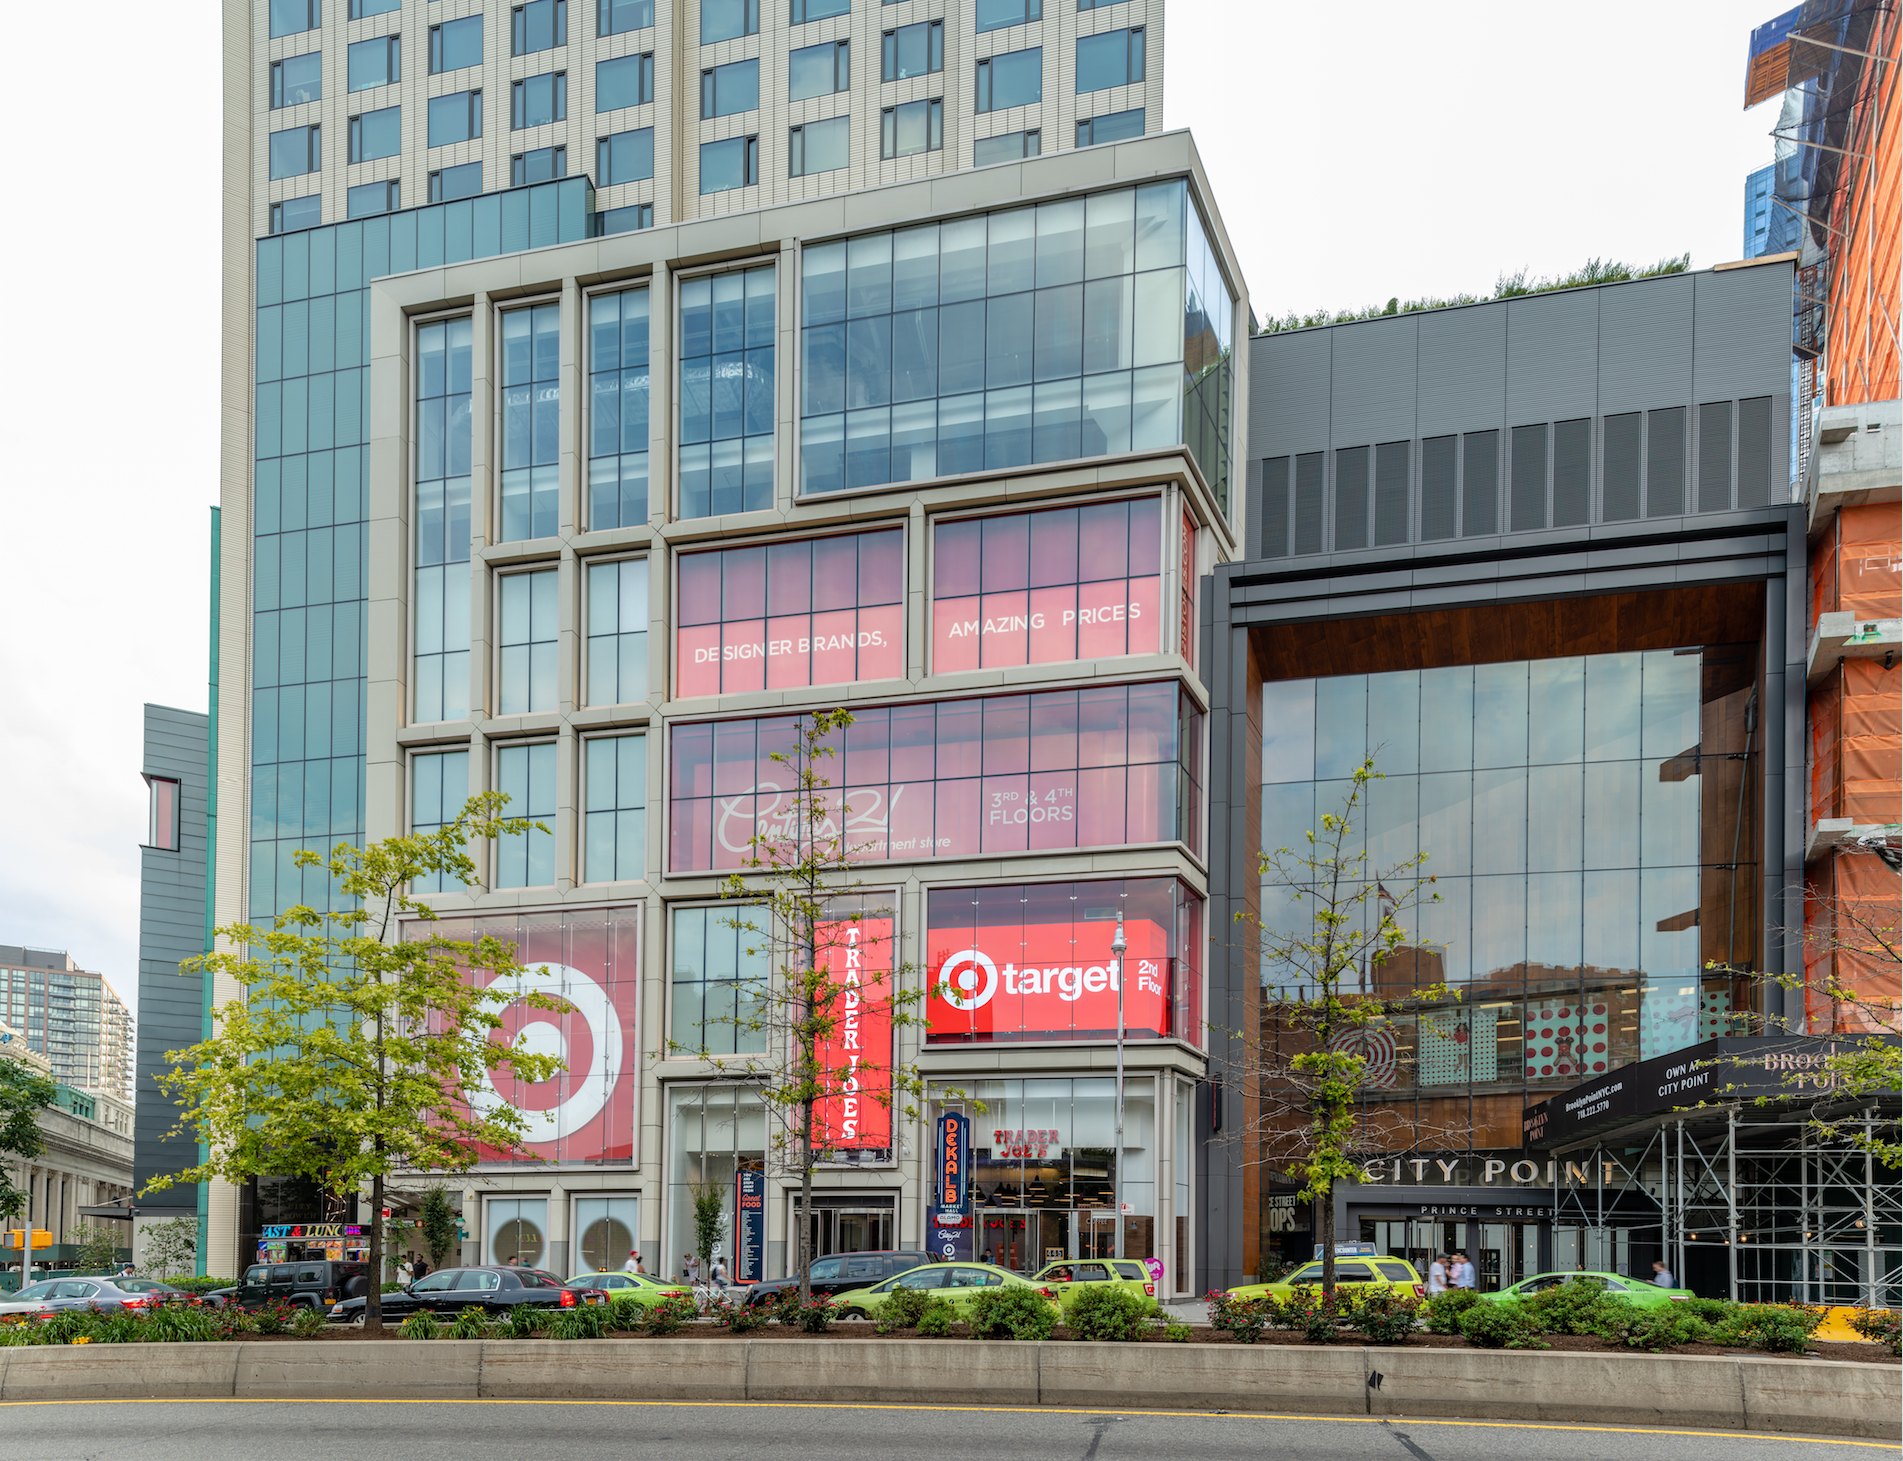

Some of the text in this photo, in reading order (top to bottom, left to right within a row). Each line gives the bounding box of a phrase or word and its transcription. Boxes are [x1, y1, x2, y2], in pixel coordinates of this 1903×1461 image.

[948, 603, 1142, 639] AMAZING PRICES
[695, 630, 888, 664] DESIGNER BRANDS,
[991, 787, 1074, 808] 3RD & 4TH
[990, 804, 1074, 826] FLOORS
[840, 836, 951, 856] department store
[1138, 960, 1159, 978] 2nd
[1002, 959, 1121, 1002] target
[1138, 976, 1162, 997] Floor
[841, 927, 861, 1140] TRADER JOES
[1665, 1059, 1702, 1080] OWN AT
[1657, 1072, 1710, 1098] CITY POINT
[1565, 1081, 1623, 1113] BrooklynPointNYC.com
[1577, 1100, 1610, 1121] 718.222.5770
[994, 1130, 1059, 1143] TRADER
[1530, 1126, 1544, 1142] POINT
[945, 1119, 958, 1204] DEKALB
[1000, 1144, 1048, 1158] JOE'S
[1364, 1159, 1619, 1184] CITY POINT
[1274, 1196, 1296, 1207] STREET
[1421, 1206, 1555, 1216] PRINCE STREET
[1145, 1261, 1160, 1272] lyft
